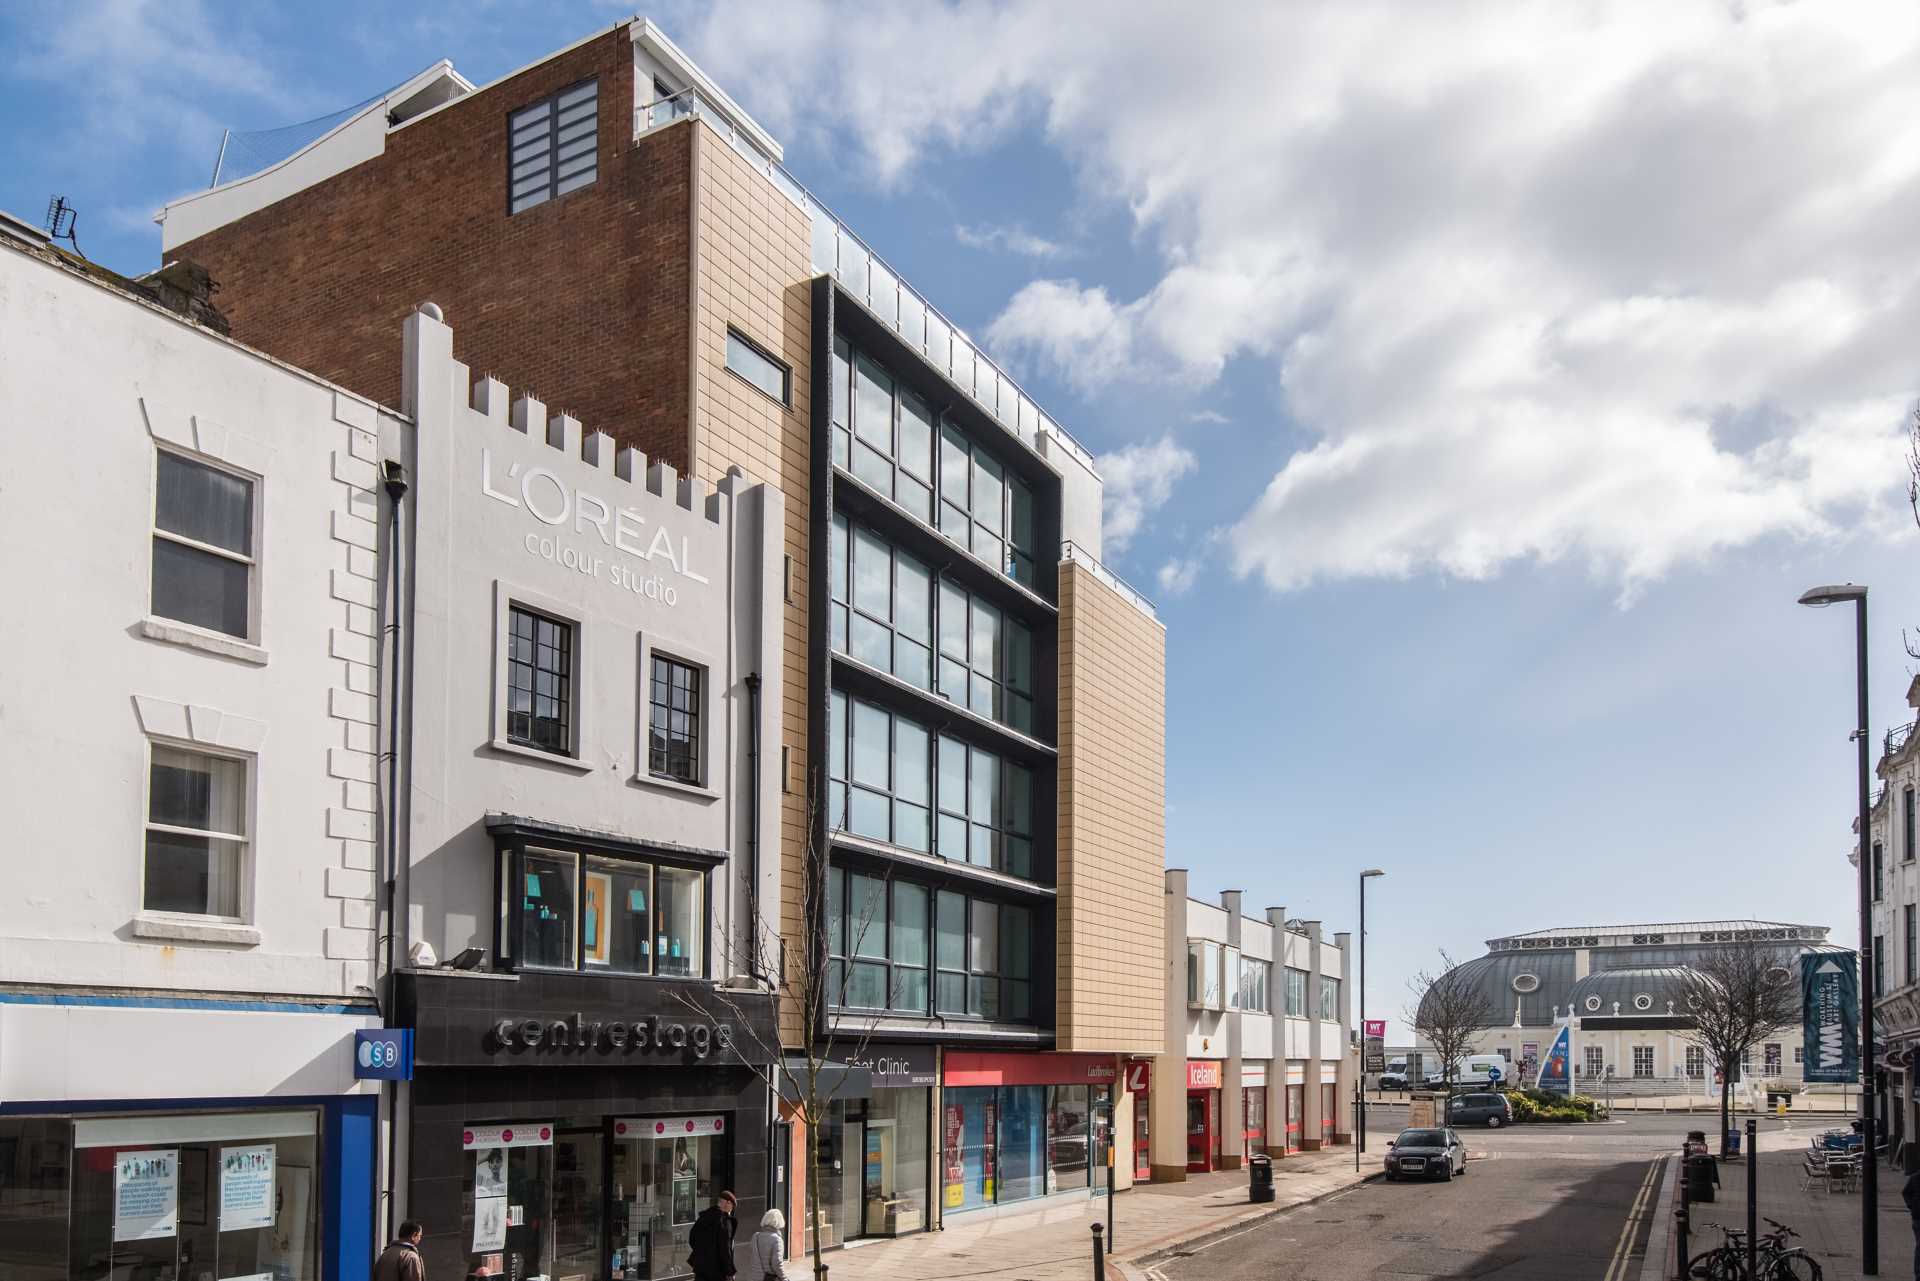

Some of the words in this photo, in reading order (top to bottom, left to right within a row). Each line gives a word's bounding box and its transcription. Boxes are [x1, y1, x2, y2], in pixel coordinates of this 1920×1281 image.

[524, 533, 604, 578] colour
[609, 561, 677, 607] studio
[1825, 994, 1833, 1025] MUSEUM
[495, 1012, 732, 1059] centrestage
[877, 1057, 910, 1075] Clinic
[1190, 1064, 1217, 1086] Iceland
